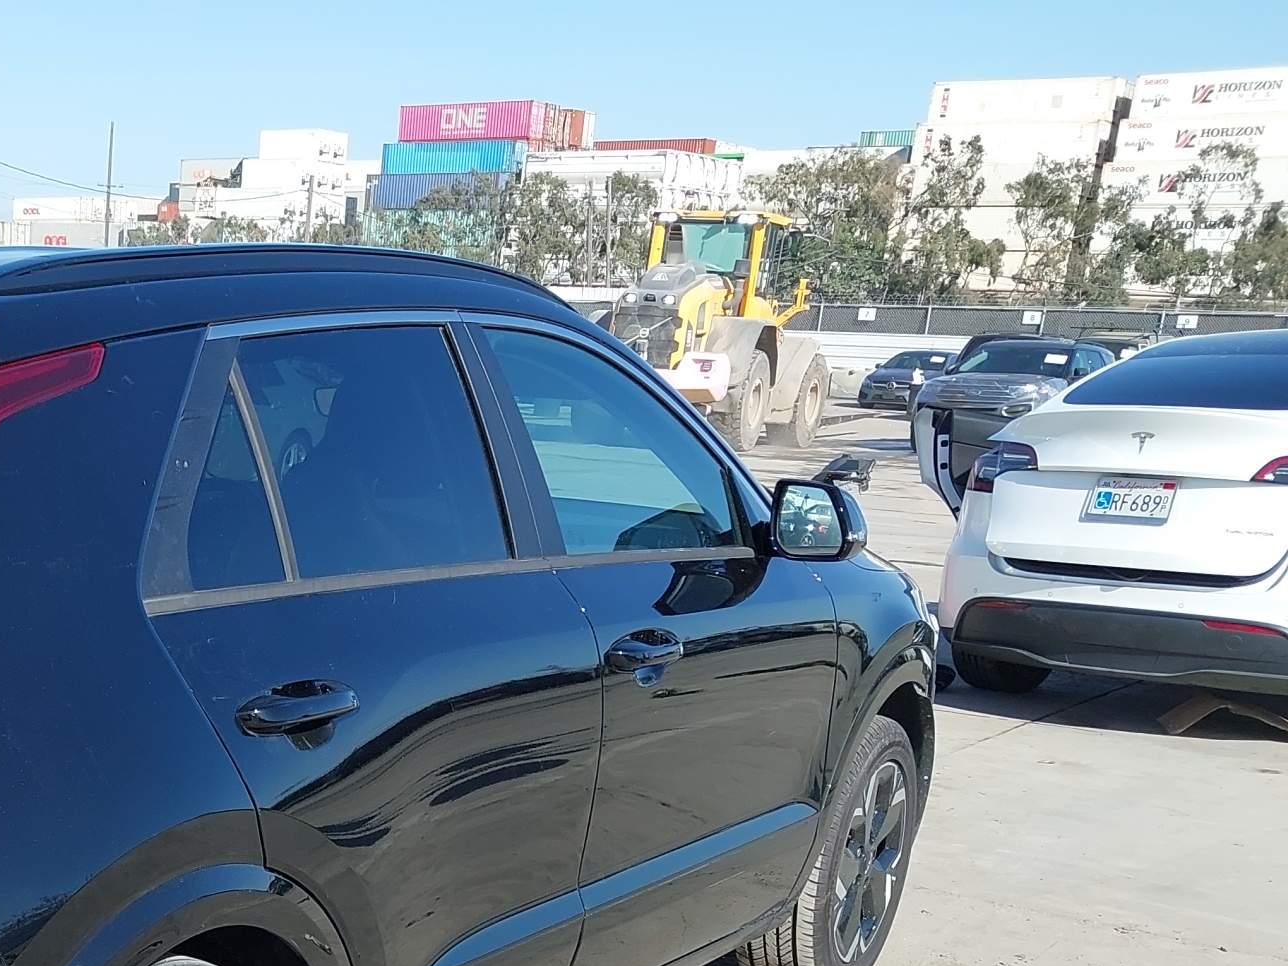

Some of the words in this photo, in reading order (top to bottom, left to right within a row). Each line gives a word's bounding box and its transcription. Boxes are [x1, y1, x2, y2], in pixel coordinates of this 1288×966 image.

[1217, 80, 1284, 93] HORIZON
[440, 107, 487, 129] ONE
[1200, 126, 1266, 138] HORIZON
[1182, 172, 1249, 183] HORIZON
[1109, 493, 1163, 513] RF689
